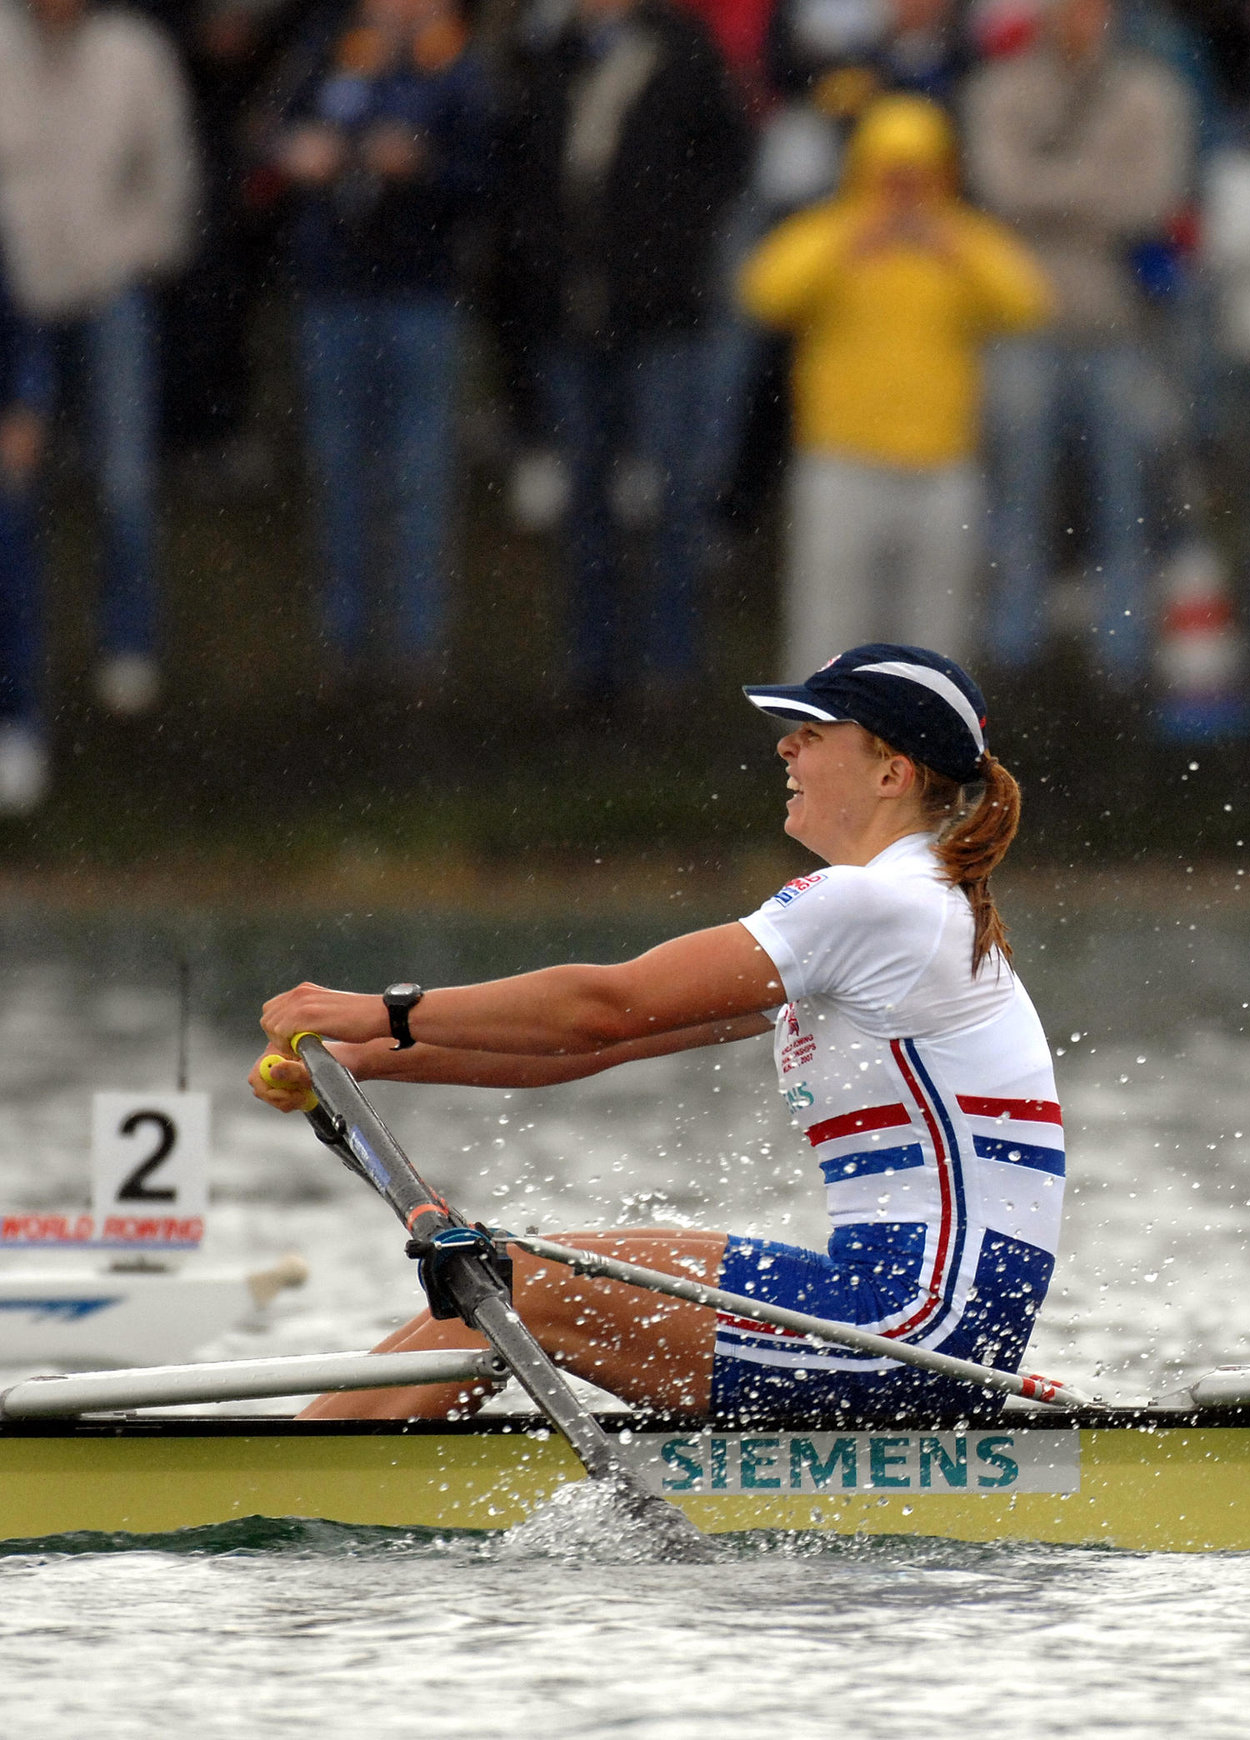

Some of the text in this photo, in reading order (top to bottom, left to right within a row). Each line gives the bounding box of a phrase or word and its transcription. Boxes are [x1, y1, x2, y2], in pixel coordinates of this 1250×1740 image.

[115, 1109, 178, 1204] 2
[2, 1216, 204, 1242] WORLD ROWING
[661, 1436, 1019, 1490] SIEMENS
